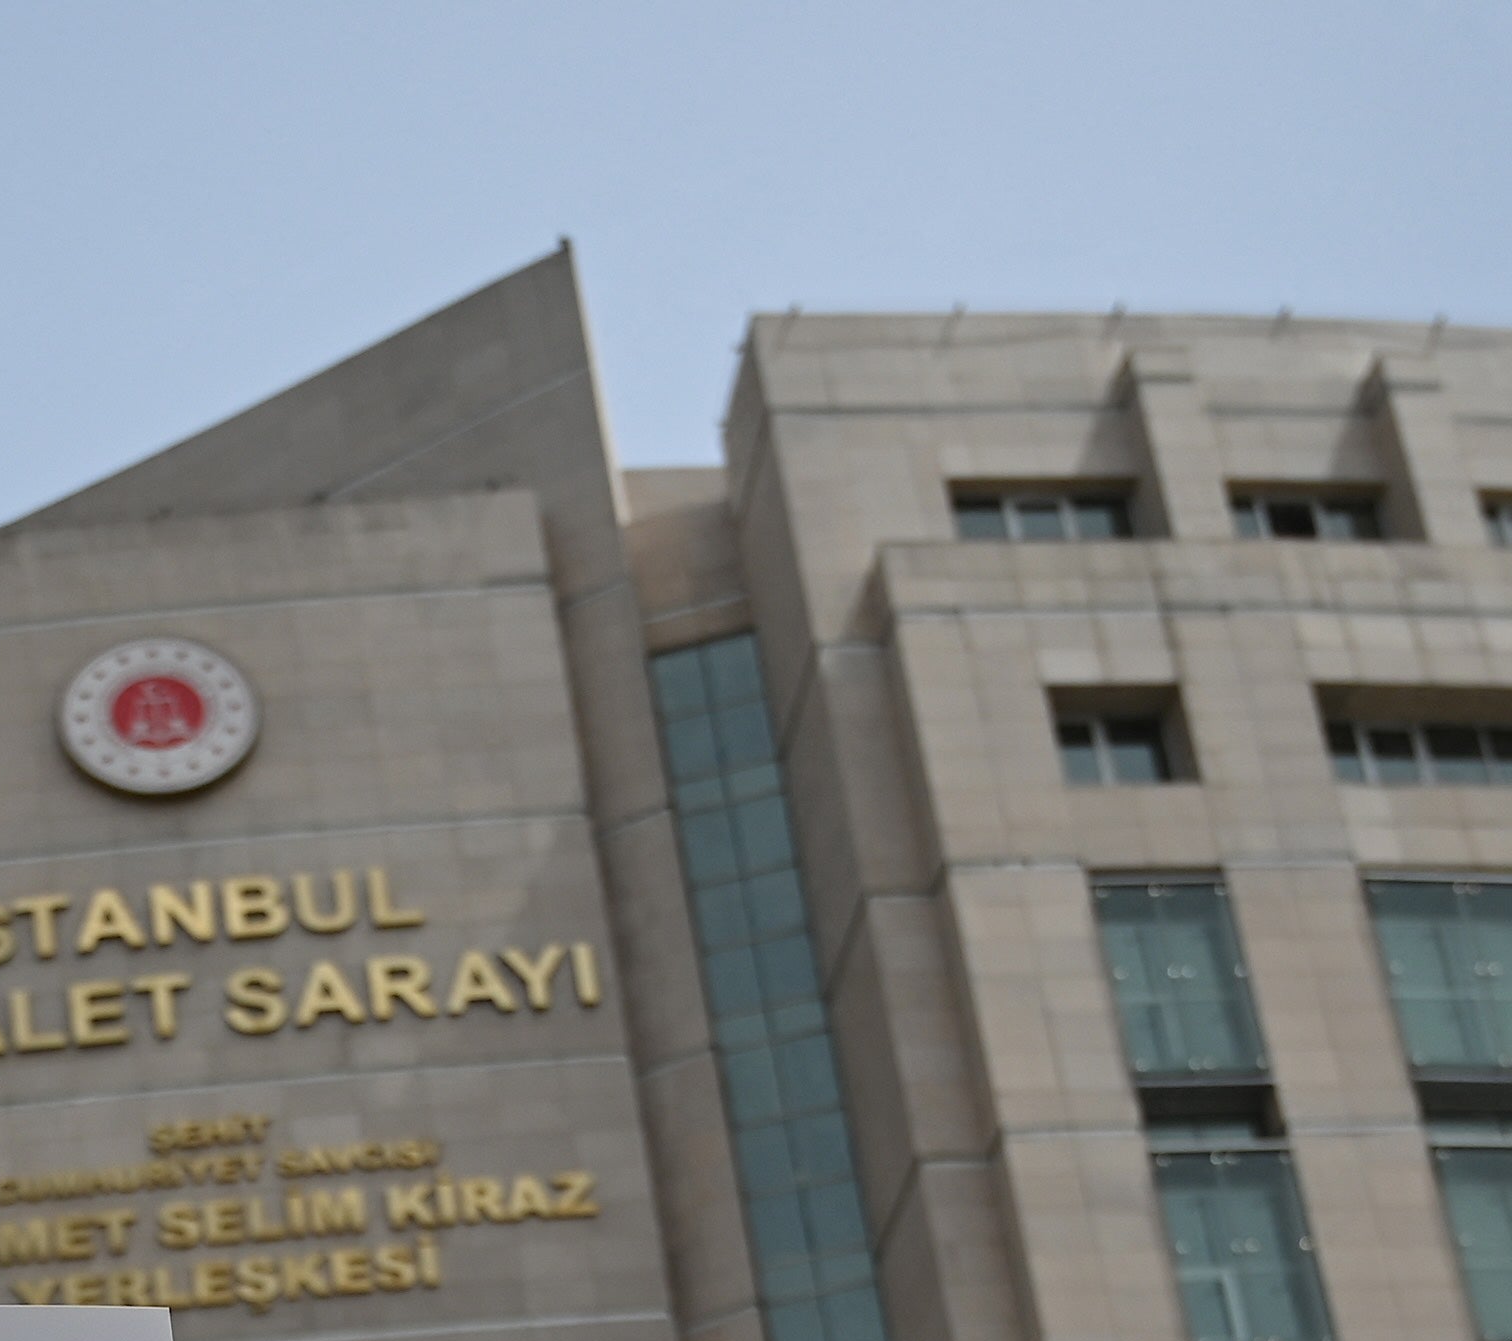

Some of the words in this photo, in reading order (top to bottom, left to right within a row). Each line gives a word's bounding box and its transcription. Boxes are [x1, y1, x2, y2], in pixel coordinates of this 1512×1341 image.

[223, 942, 603, 1036] SARAYI
[157, 1186, 366, 1250] SELİM
[387, 1169, 600, 1232] KİRAZ
